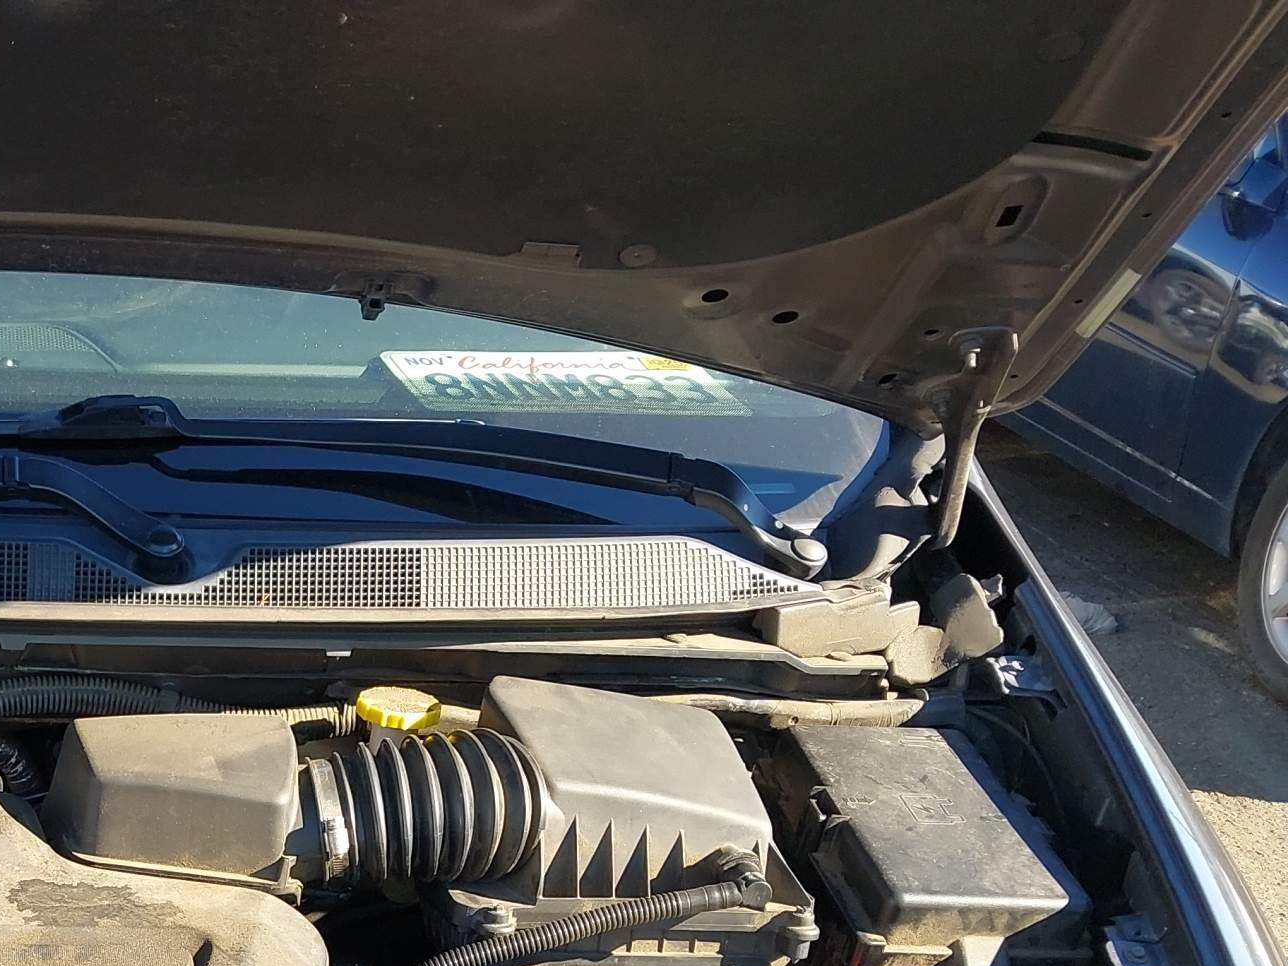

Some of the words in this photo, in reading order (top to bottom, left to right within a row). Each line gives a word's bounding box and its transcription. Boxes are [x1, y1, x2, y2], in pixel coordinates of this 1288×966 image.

[403, 356, 444, 367] NOV
[457, 355, 628, 373] California
[423, 372, 718, 402] 8NNM833
